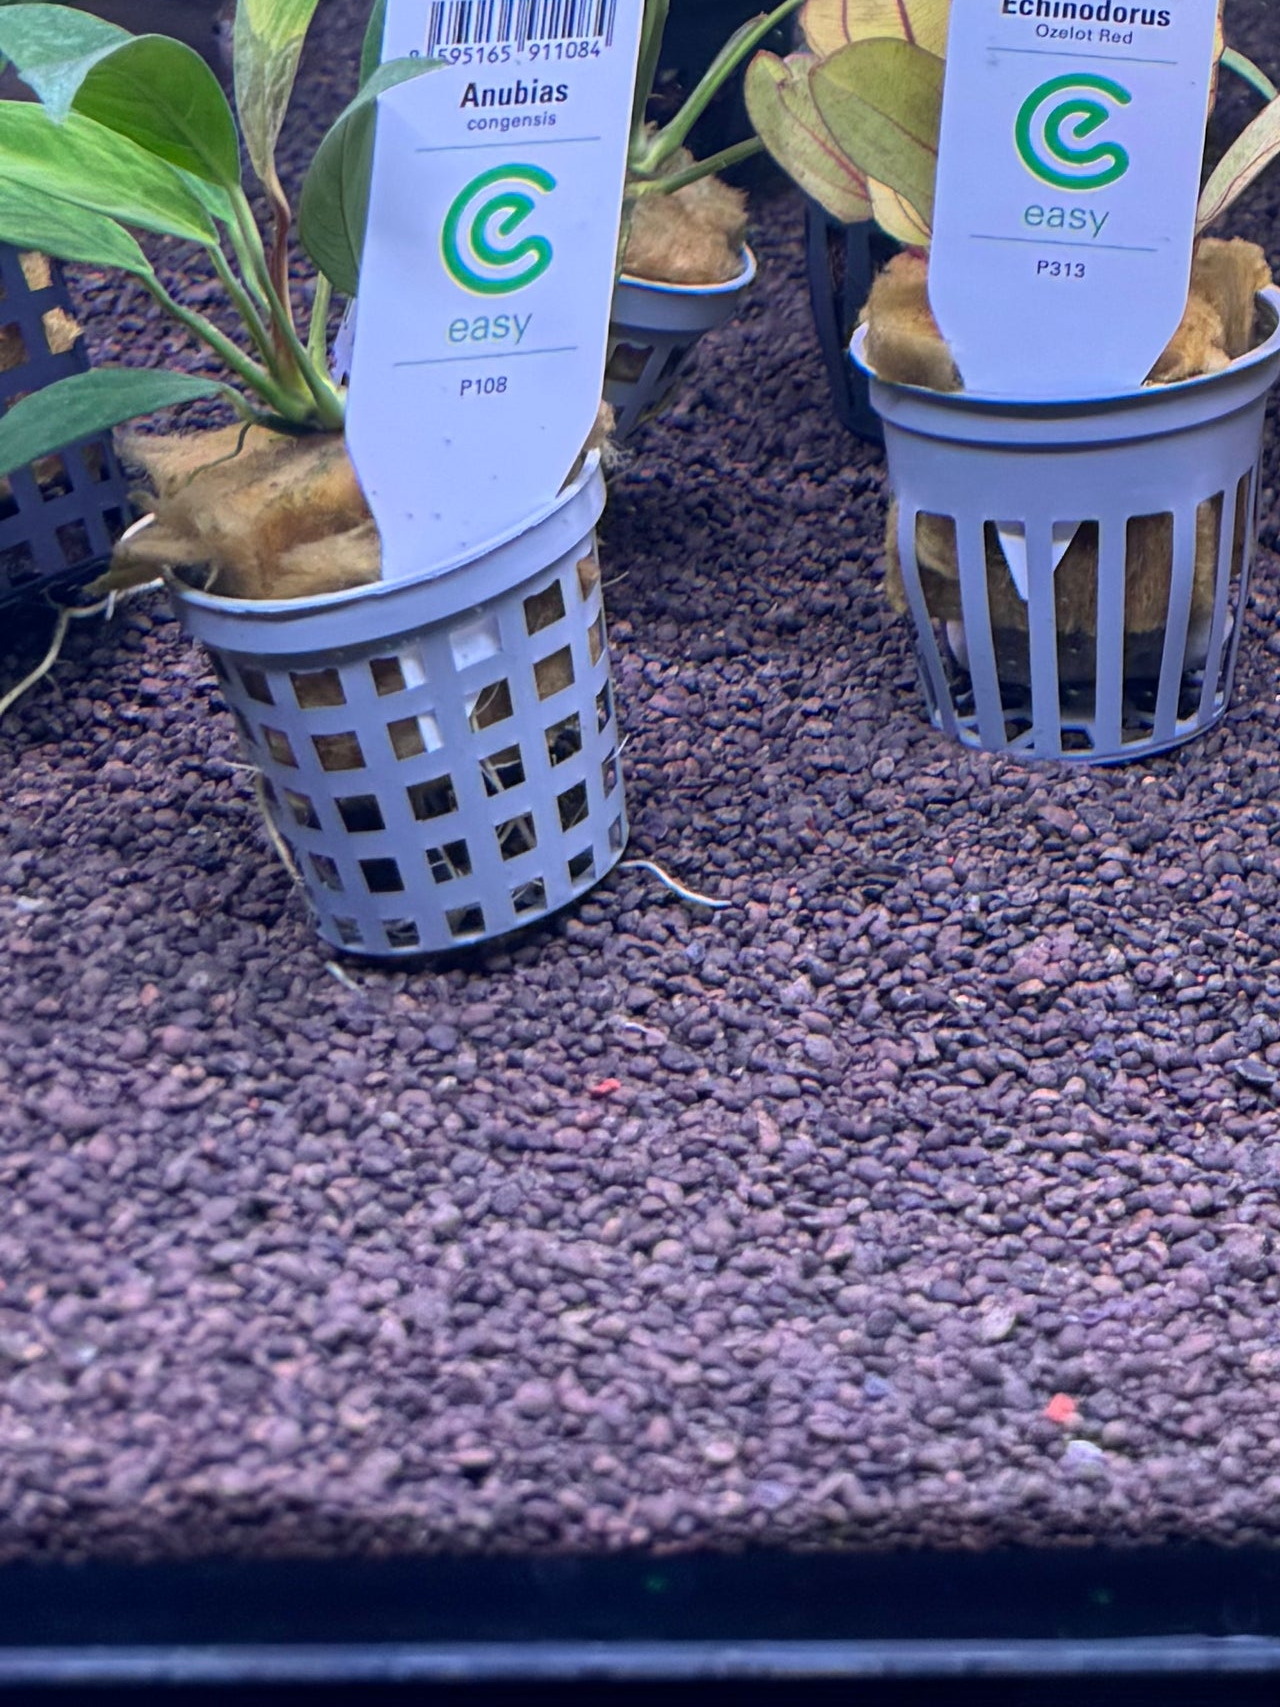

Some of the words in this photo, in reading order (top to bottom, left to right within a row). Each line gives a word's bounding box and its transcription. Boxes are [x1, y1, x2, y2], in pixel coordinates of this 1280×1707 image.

[1035, 24, 1093, 43] Ozelot
[1099, 29, 1133, 45] Red
[529, 40, 601, 62] 911084
[460, 78, 569, 108] Anubias
[467, 112, 557, 132] congensis
[1024, 204, 1110, 238] easy
[1037, 260, 1086, 278] P313
[448, 313, 533, 346] easy
[460, 376, 508, 397] P108
